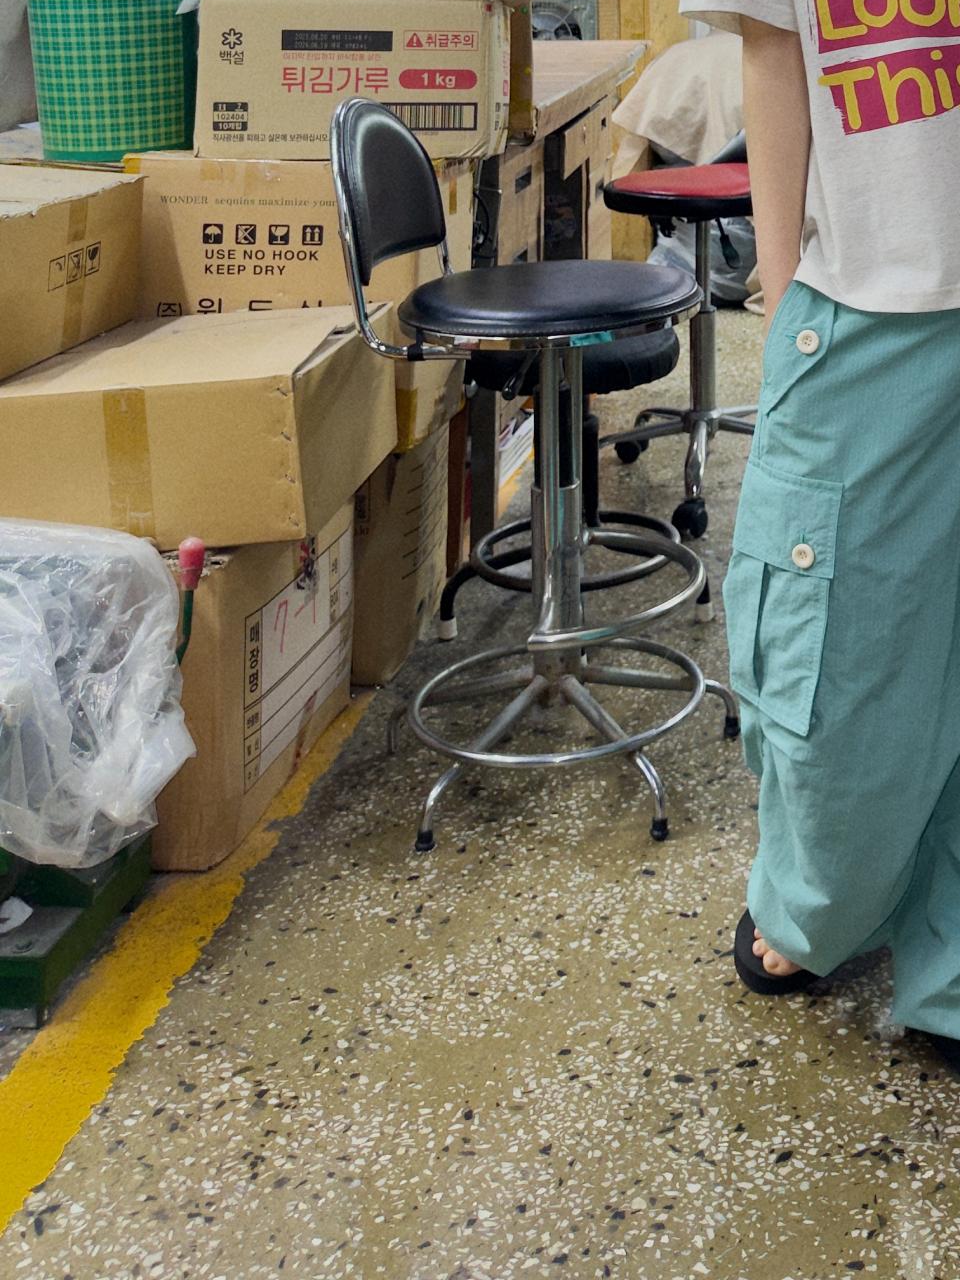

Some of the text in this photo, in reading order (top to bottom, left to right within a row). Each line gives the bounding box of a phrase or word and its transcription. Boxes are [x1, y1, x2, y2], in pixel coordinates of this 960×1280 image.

[425, 33, 476, 49] 취급주의
[219, 50, 245, 65] 백설
[281, 66, 389, 94] 튀김가루
[421, 72, 457, 89] 1 kg
[160, 195, 208, 205] WONDER
[215, 197, 255, 207] sequins
[258, 197, 309, 207] maximize
[205, 249, 319, 261] USE NO HOOK
[204, 264, 286, 276] KEEP DRY
